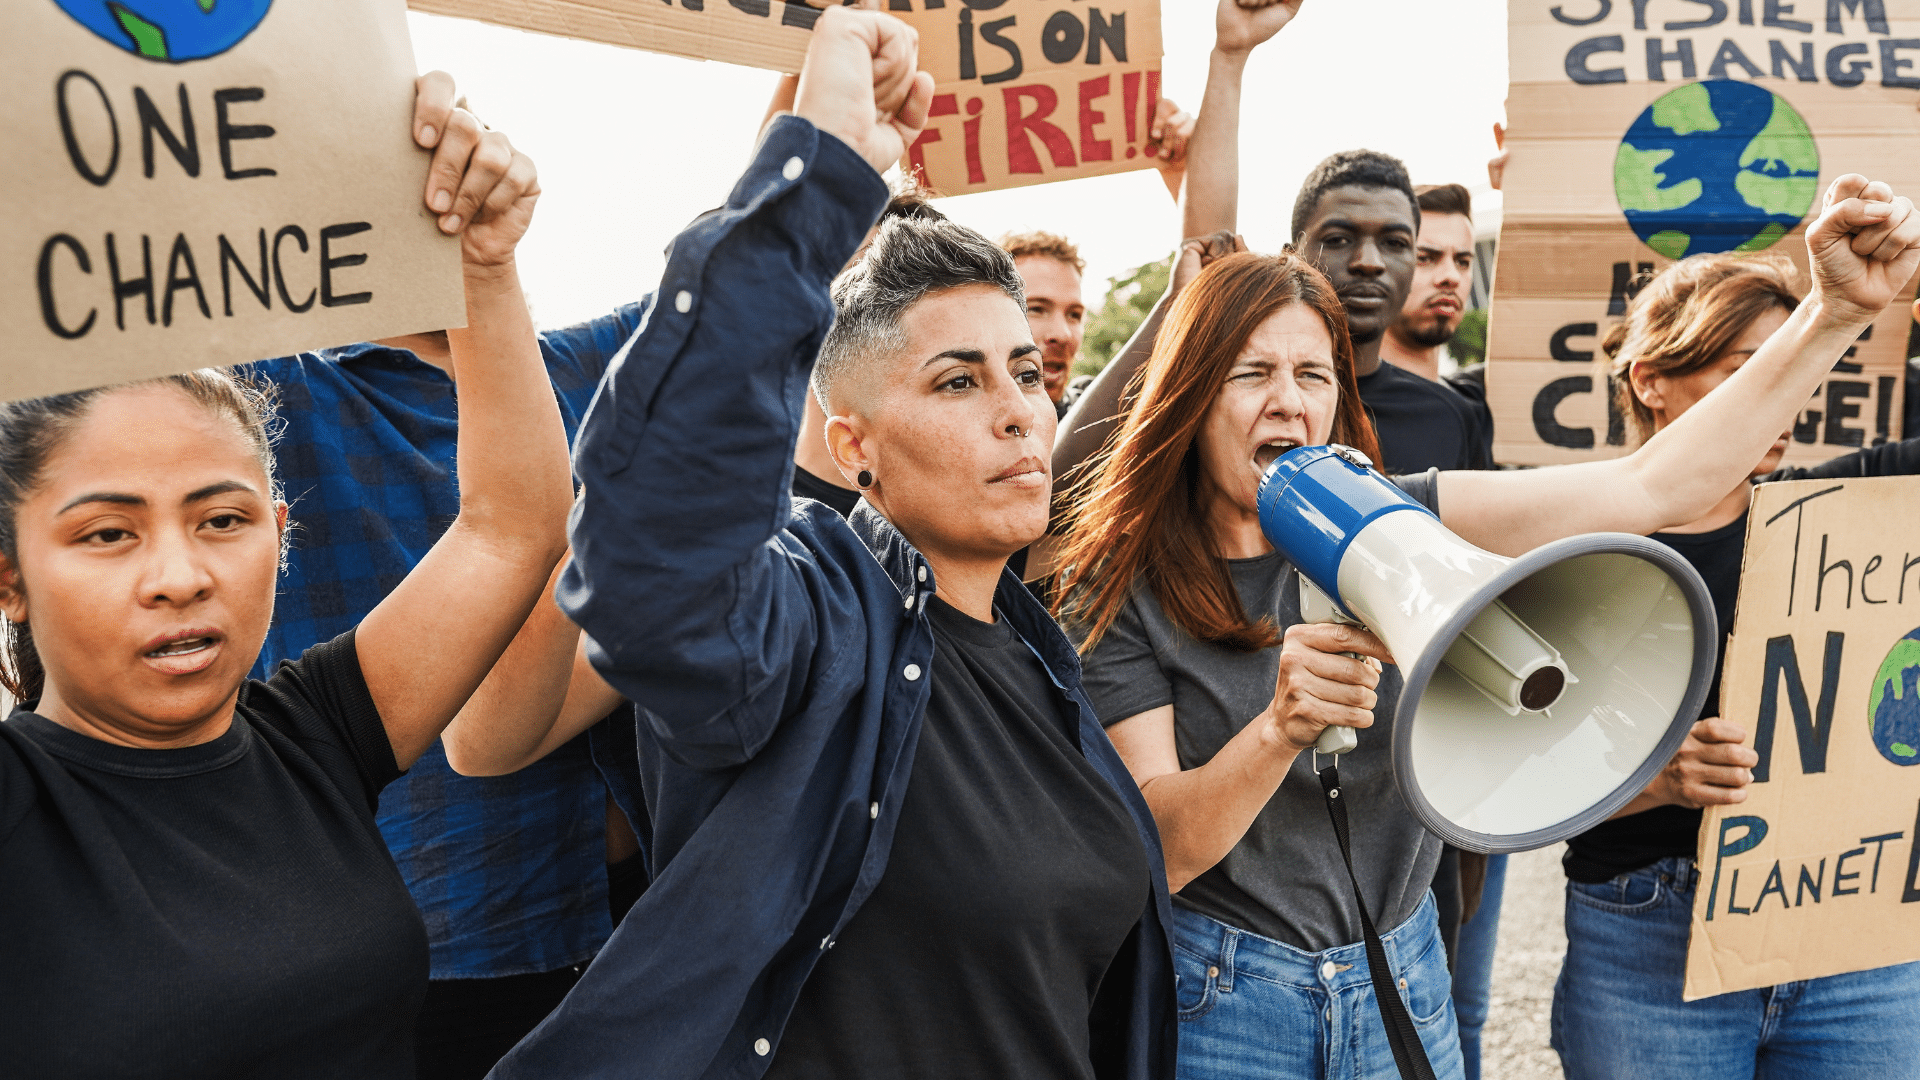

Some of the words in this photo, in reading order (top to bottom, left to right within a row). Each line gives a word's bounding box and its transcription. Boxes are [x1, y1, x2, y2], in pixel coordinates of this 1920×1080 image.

[1041, 7, 1129, 64] ON
[1564, 34, 1920, 90] CHANGE
[56, 69, 277, 186] ONE
[36, 221, 373, 340] CHANCE
[1766, 484, 1920, 617] Ther
[1705, 815, 1905, 922] PLANET
